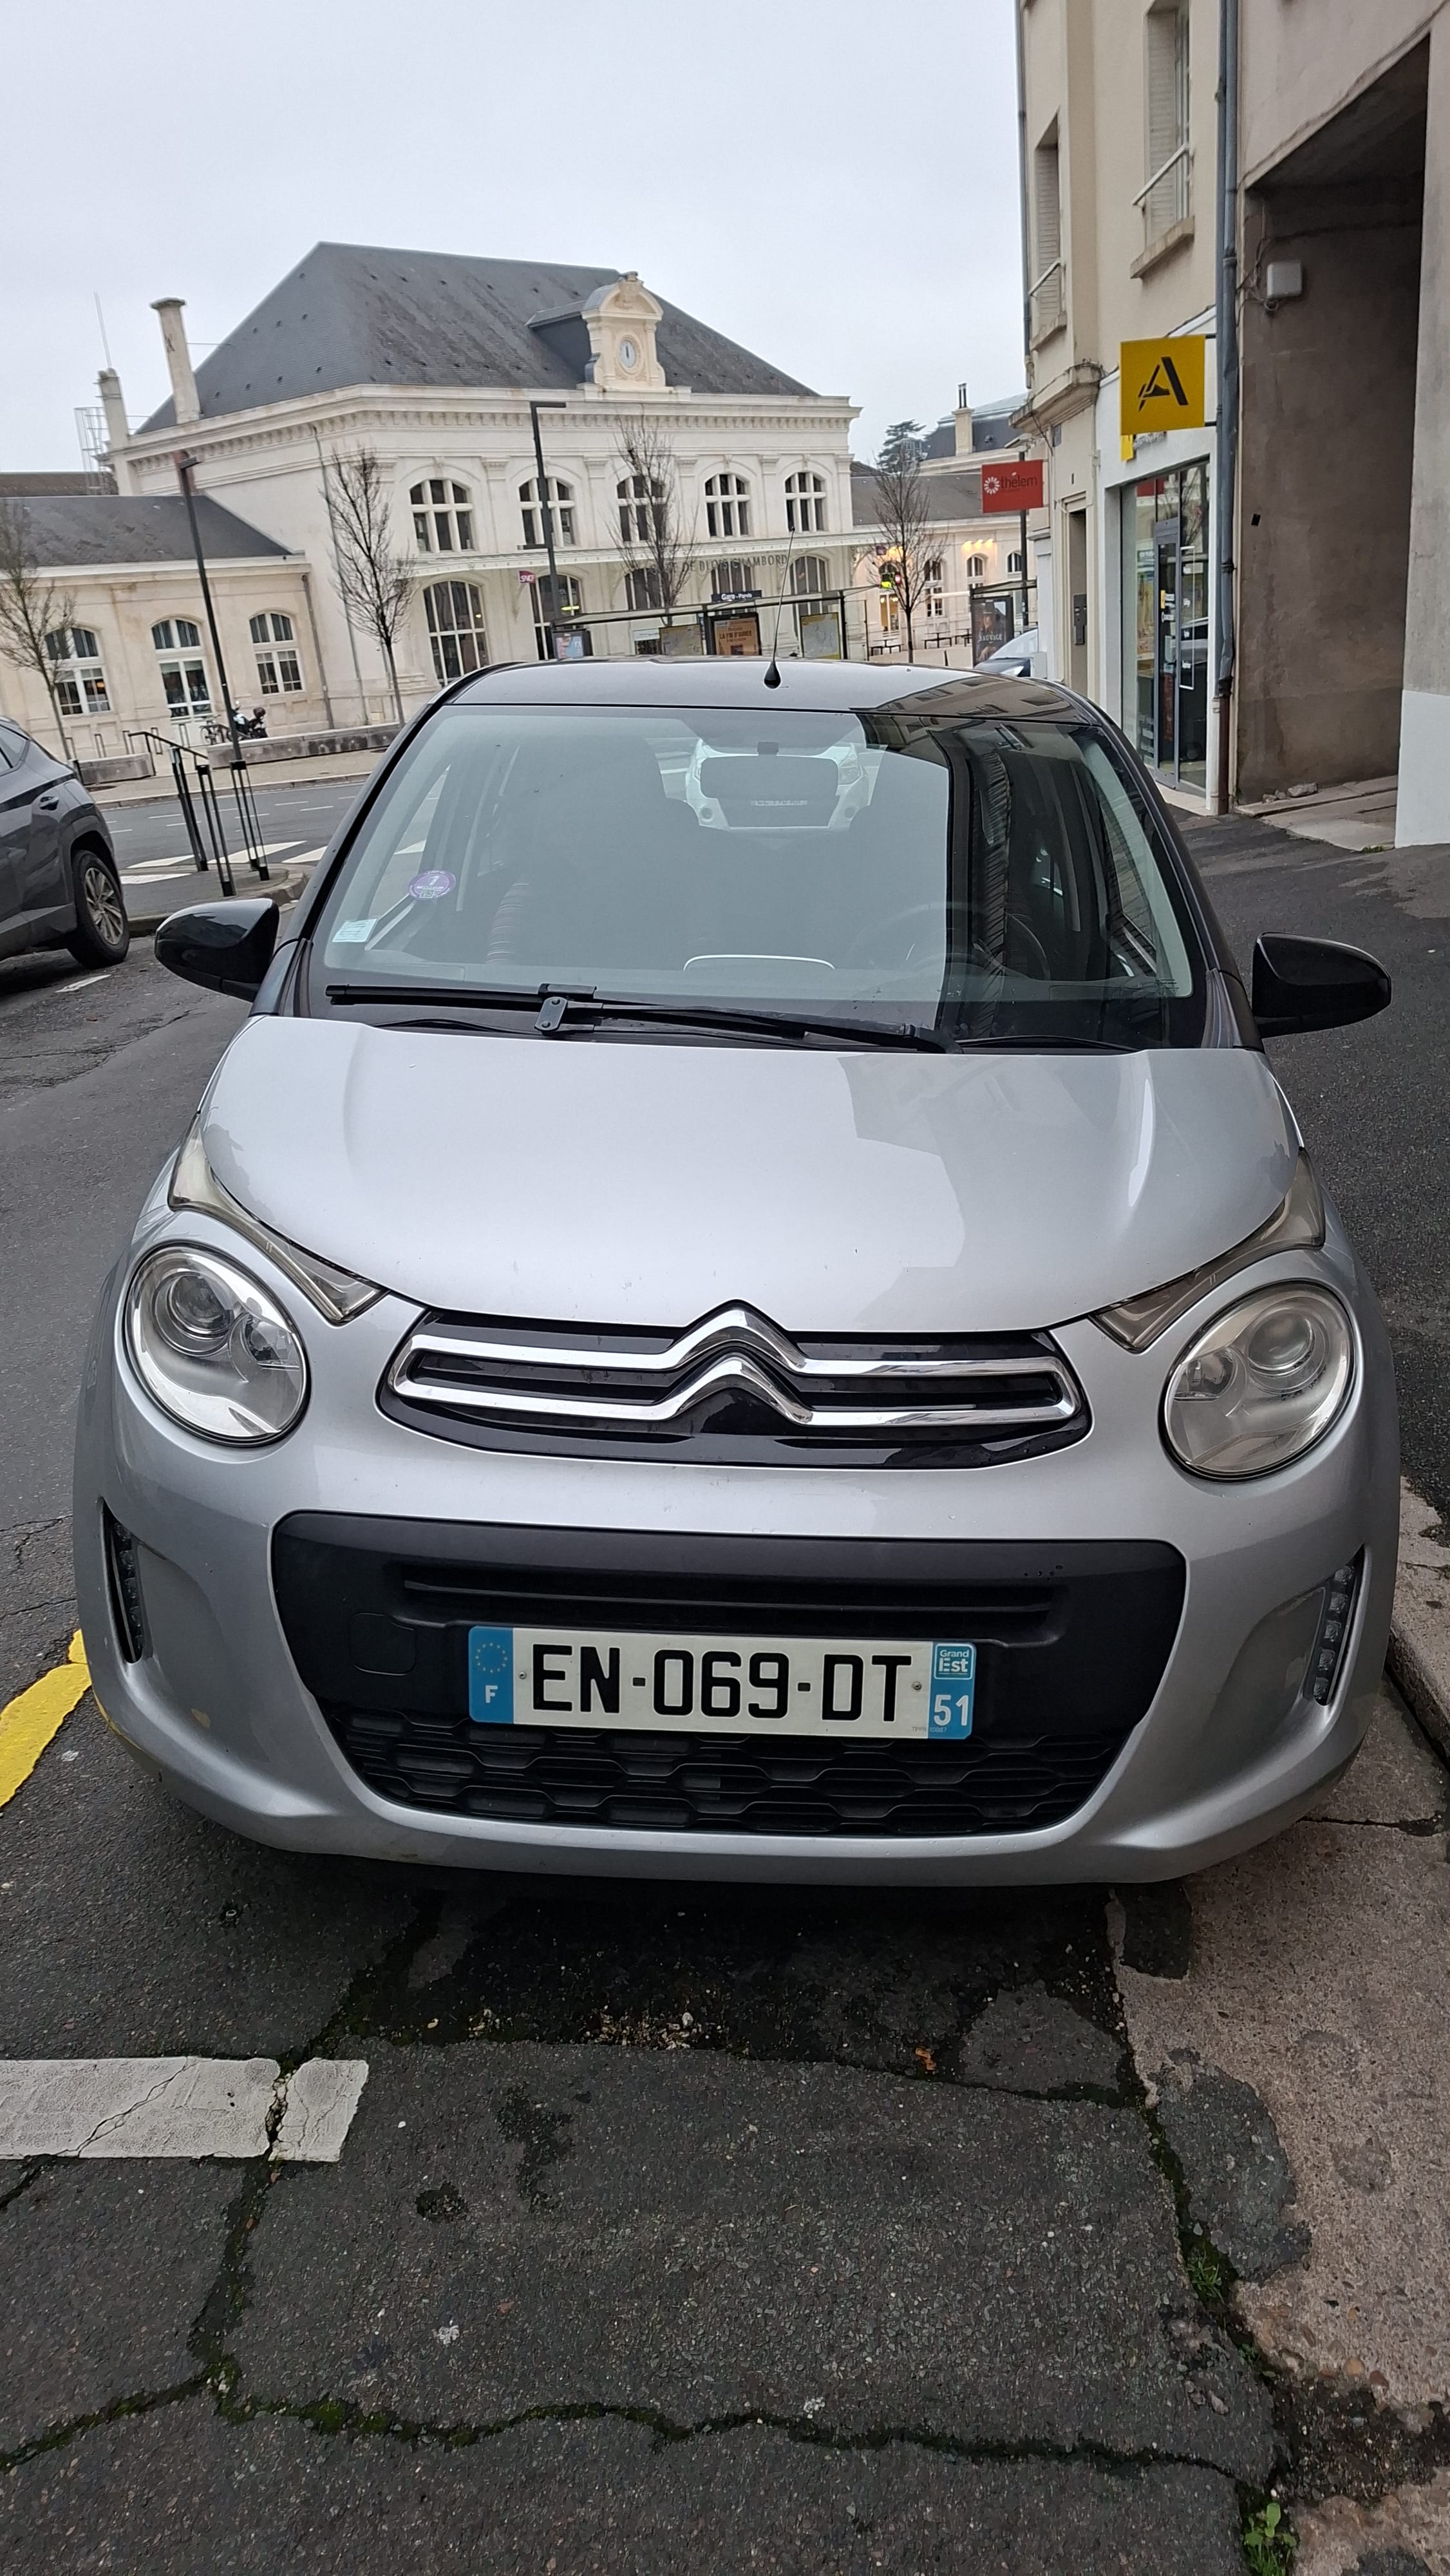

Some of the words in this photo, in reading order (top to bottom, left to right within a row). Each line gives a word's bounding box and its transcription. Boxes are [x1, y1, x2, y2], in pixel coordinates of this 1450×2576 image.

[939, 1649, 970, 1658] Grand
[938, 1658, 968, 1672] Est
[532, 1643, 912, 1723] EN-069-DT
[485, 1685, 498, 1704] F
[934, 1694, 969, 1726] 51
